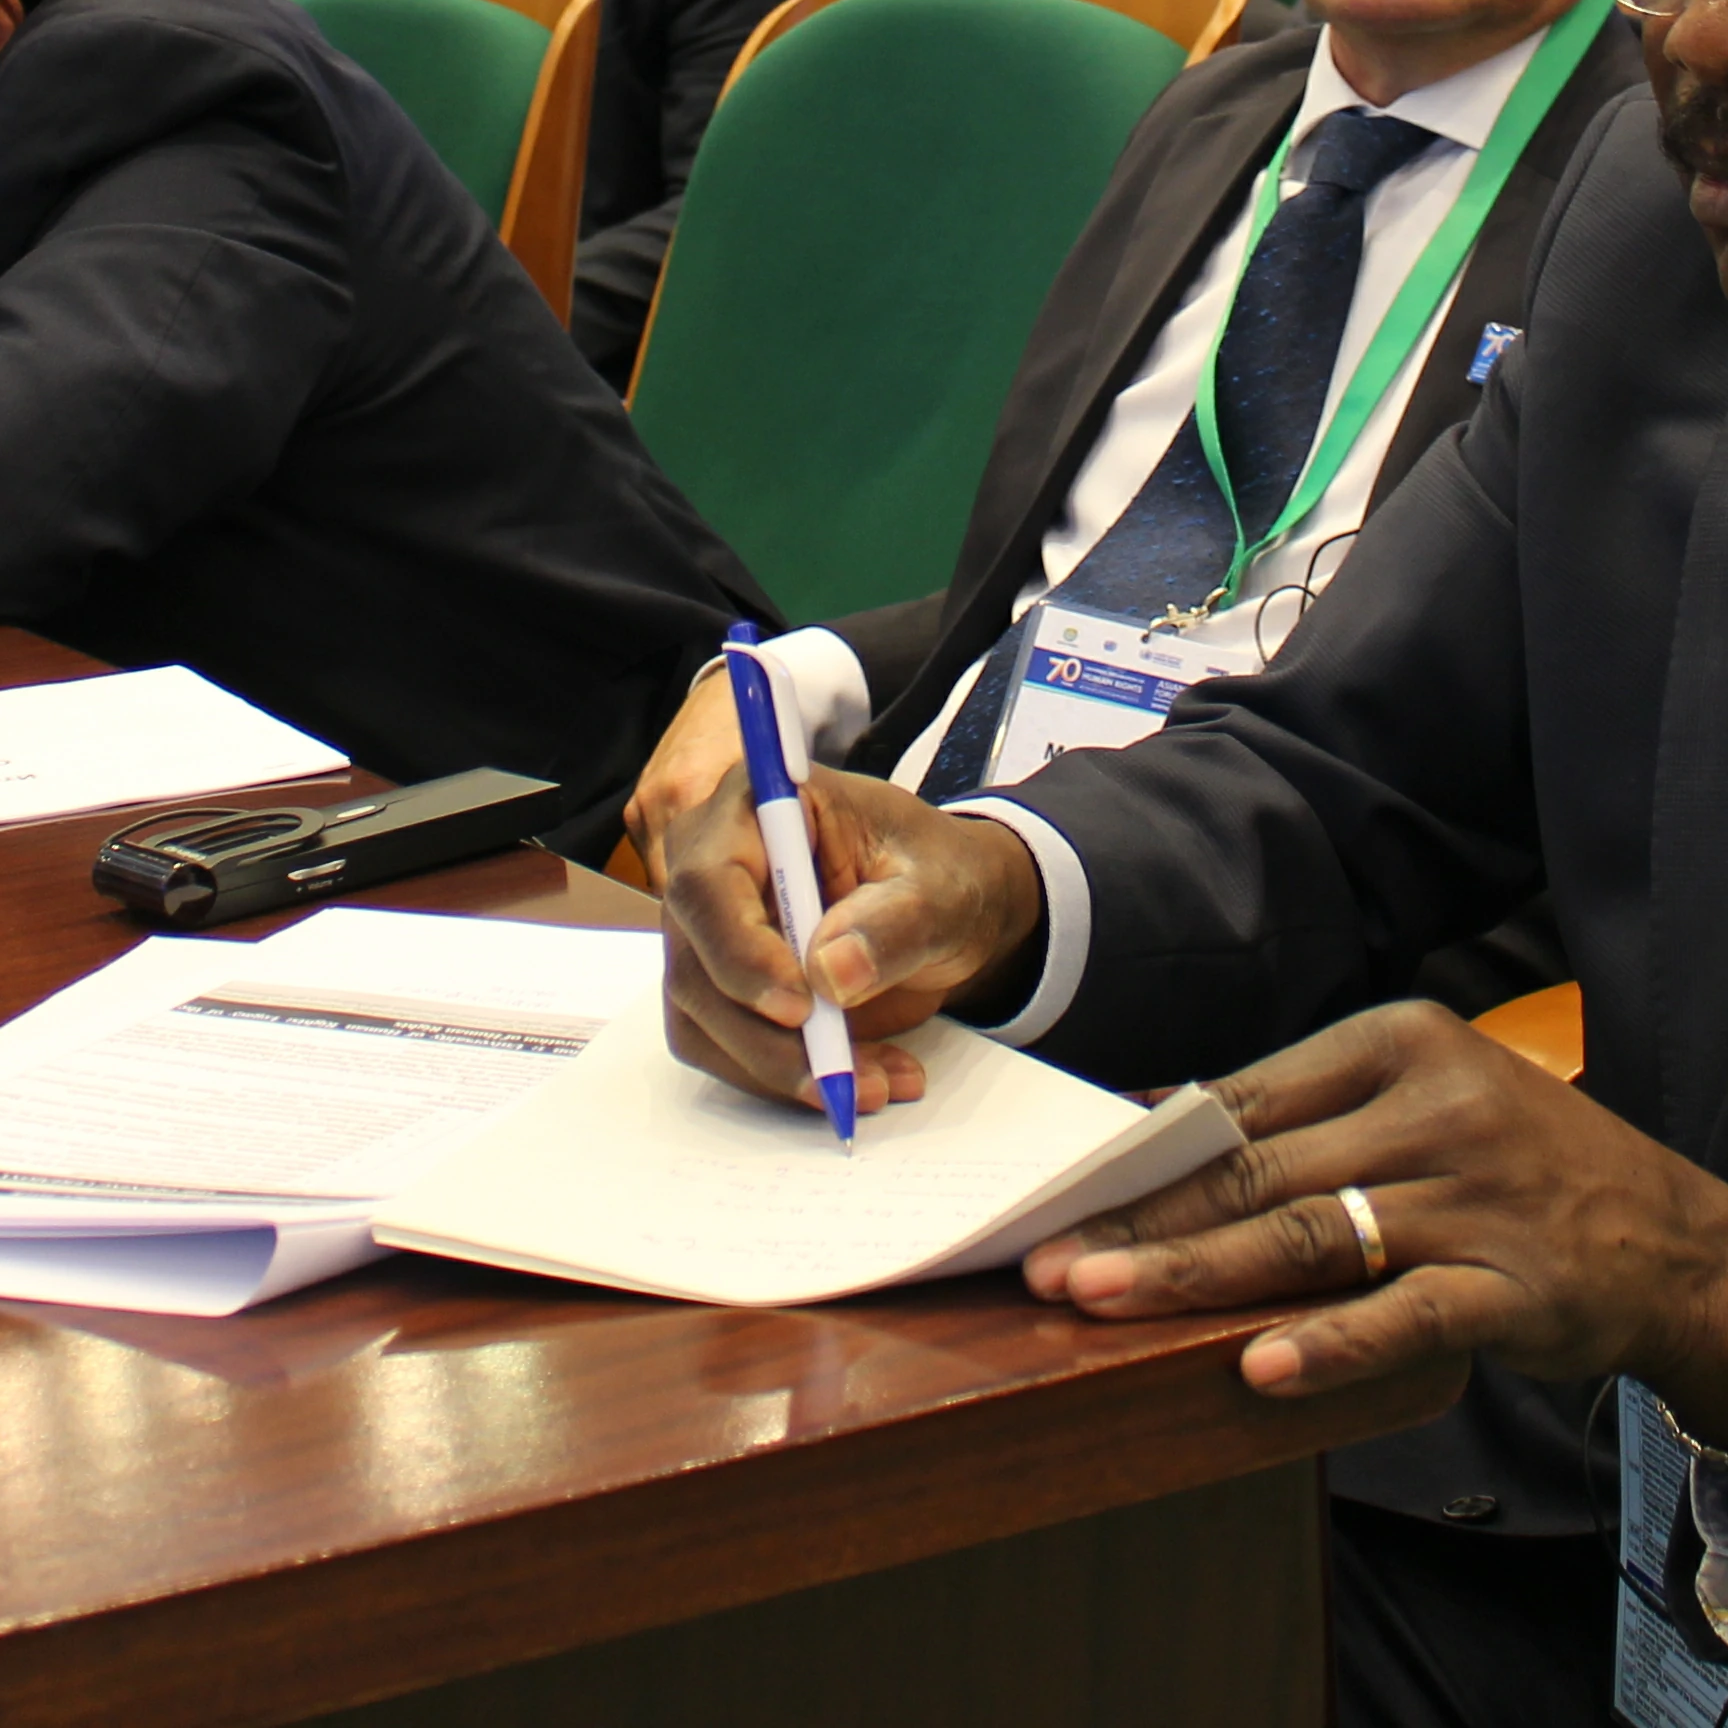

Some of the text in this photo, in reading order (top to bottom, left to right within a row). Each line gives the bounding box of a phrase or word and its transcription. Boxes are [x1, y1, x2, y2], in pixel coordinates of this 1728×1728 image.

[1046, 657, 1082, 683] 70
[1114, 680, 1143, 693] RIGHTS
[775, 868, 802, 965] sianforum.uz
[392, 1020, 443, 1033] Rights
